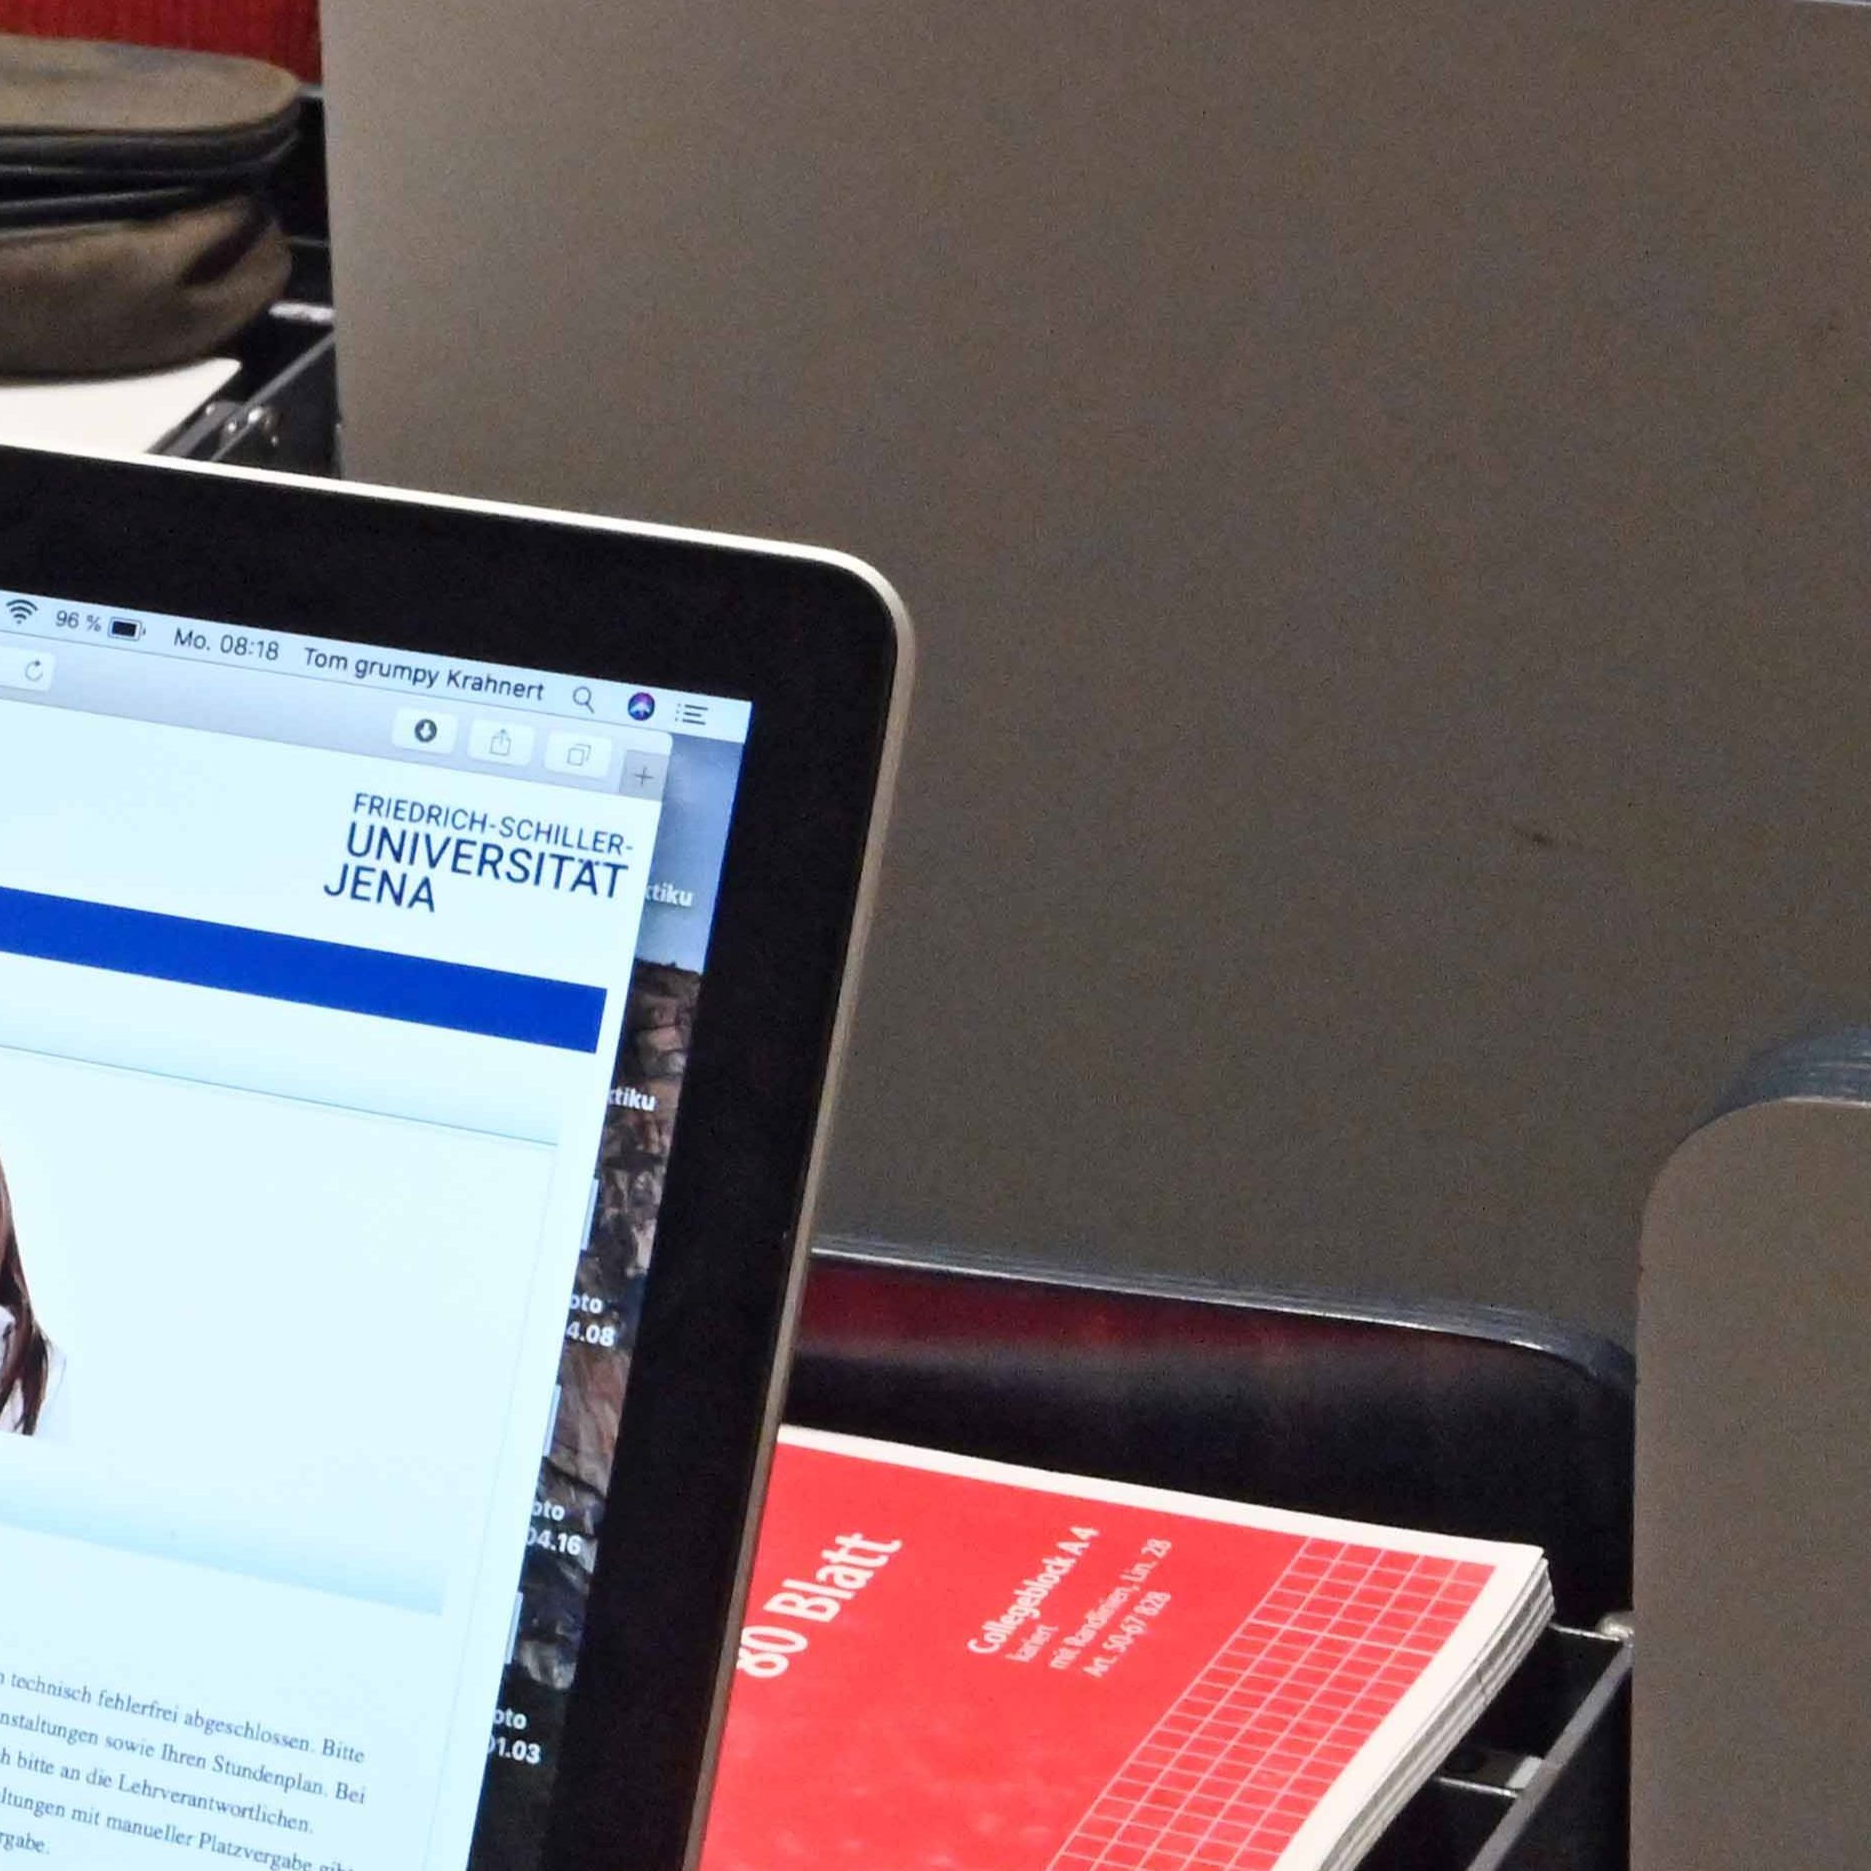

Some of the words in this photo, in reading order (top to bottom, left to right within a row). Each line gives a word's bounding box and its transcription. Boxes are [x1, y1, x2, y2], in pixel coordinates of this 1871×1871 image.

[55, 609, 80, 629] 96
[86, 614, 102, 633] %
[219, 634, 280, 661] 08:18
[304, 646, 348, 671] Tom
[354, 658, 440, 689] grumpy
[446, 669, 545, 701] Krahnert
[353, 792, 633, 856] FRIEDRICH-SCHILLER-
[323, 863, 435, 913] JENA
[346, 820, 629, 899] UNIVERSITÄT
[763, 1532, 903, 1623] Blatt
[967, 1557, 1077, 1653] Collegeblock
[10, 1673, 92, 1704] technisch
[98, 1689, 179, 1724] fehlerfrei
[322, 1737, 365, 1764] Bitte
[105, 1736, 156, 1758] sowie
[160, 1742, 207, 1770] Ihren
[334, 1781, 366, 1805] Bei
